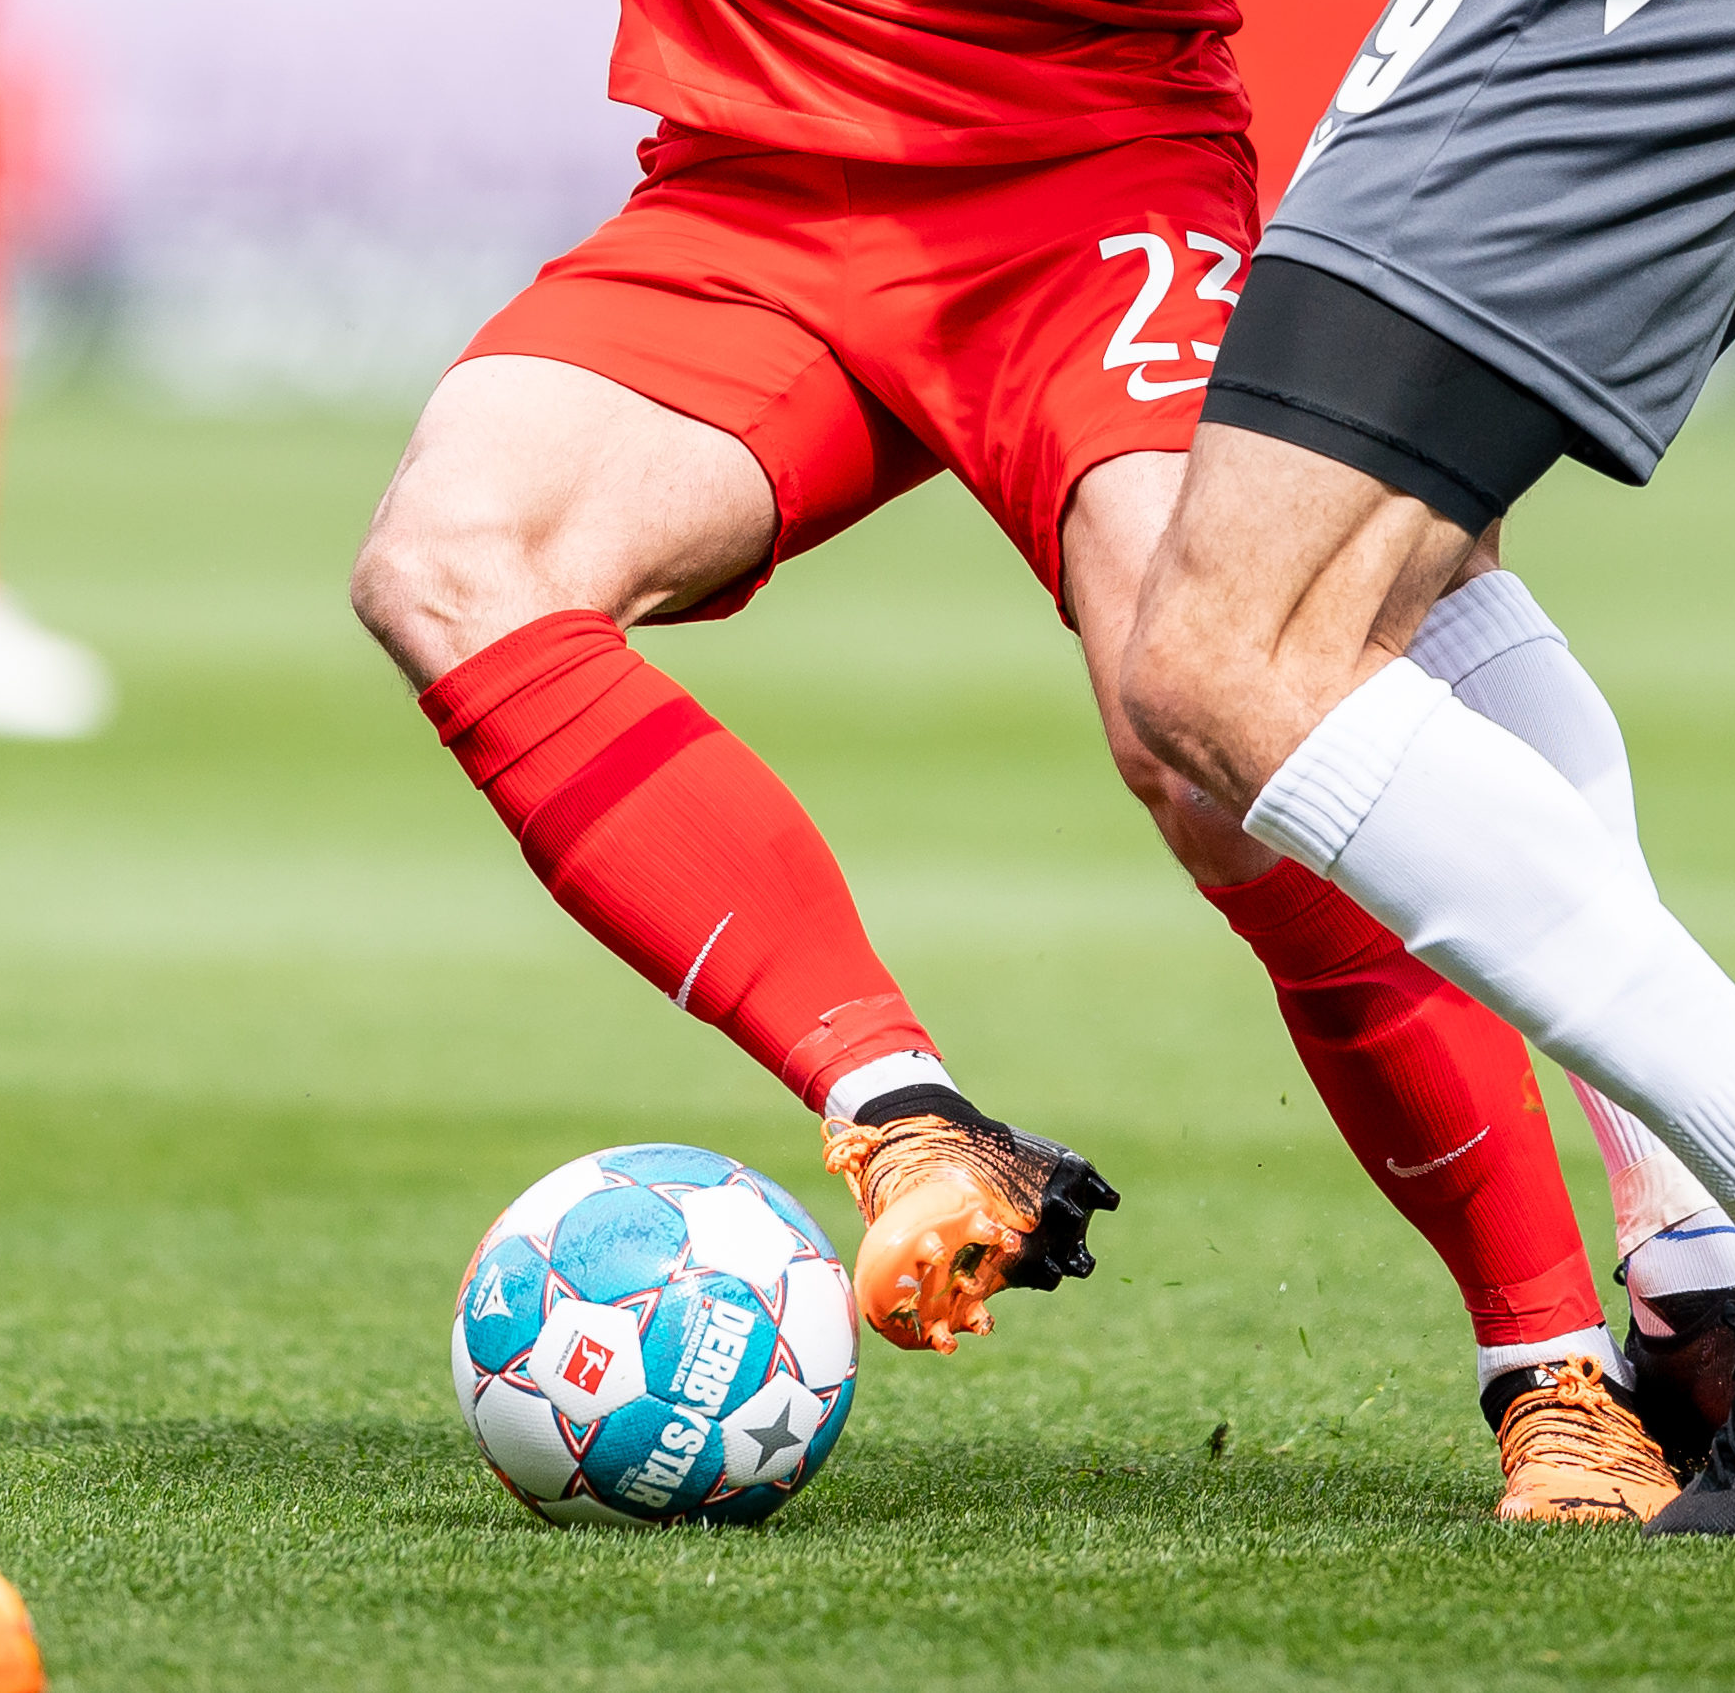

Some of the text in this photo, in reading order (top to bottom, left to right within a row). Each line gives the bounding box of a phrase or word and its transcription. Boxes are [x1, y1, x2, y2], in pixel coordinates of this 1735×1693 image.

[1098, 230, 1242, 371] 23
[623, 1298, 757, 1508] DERBYSTAR
[668, 1308, 710, 1393] BUNDESLIGA
